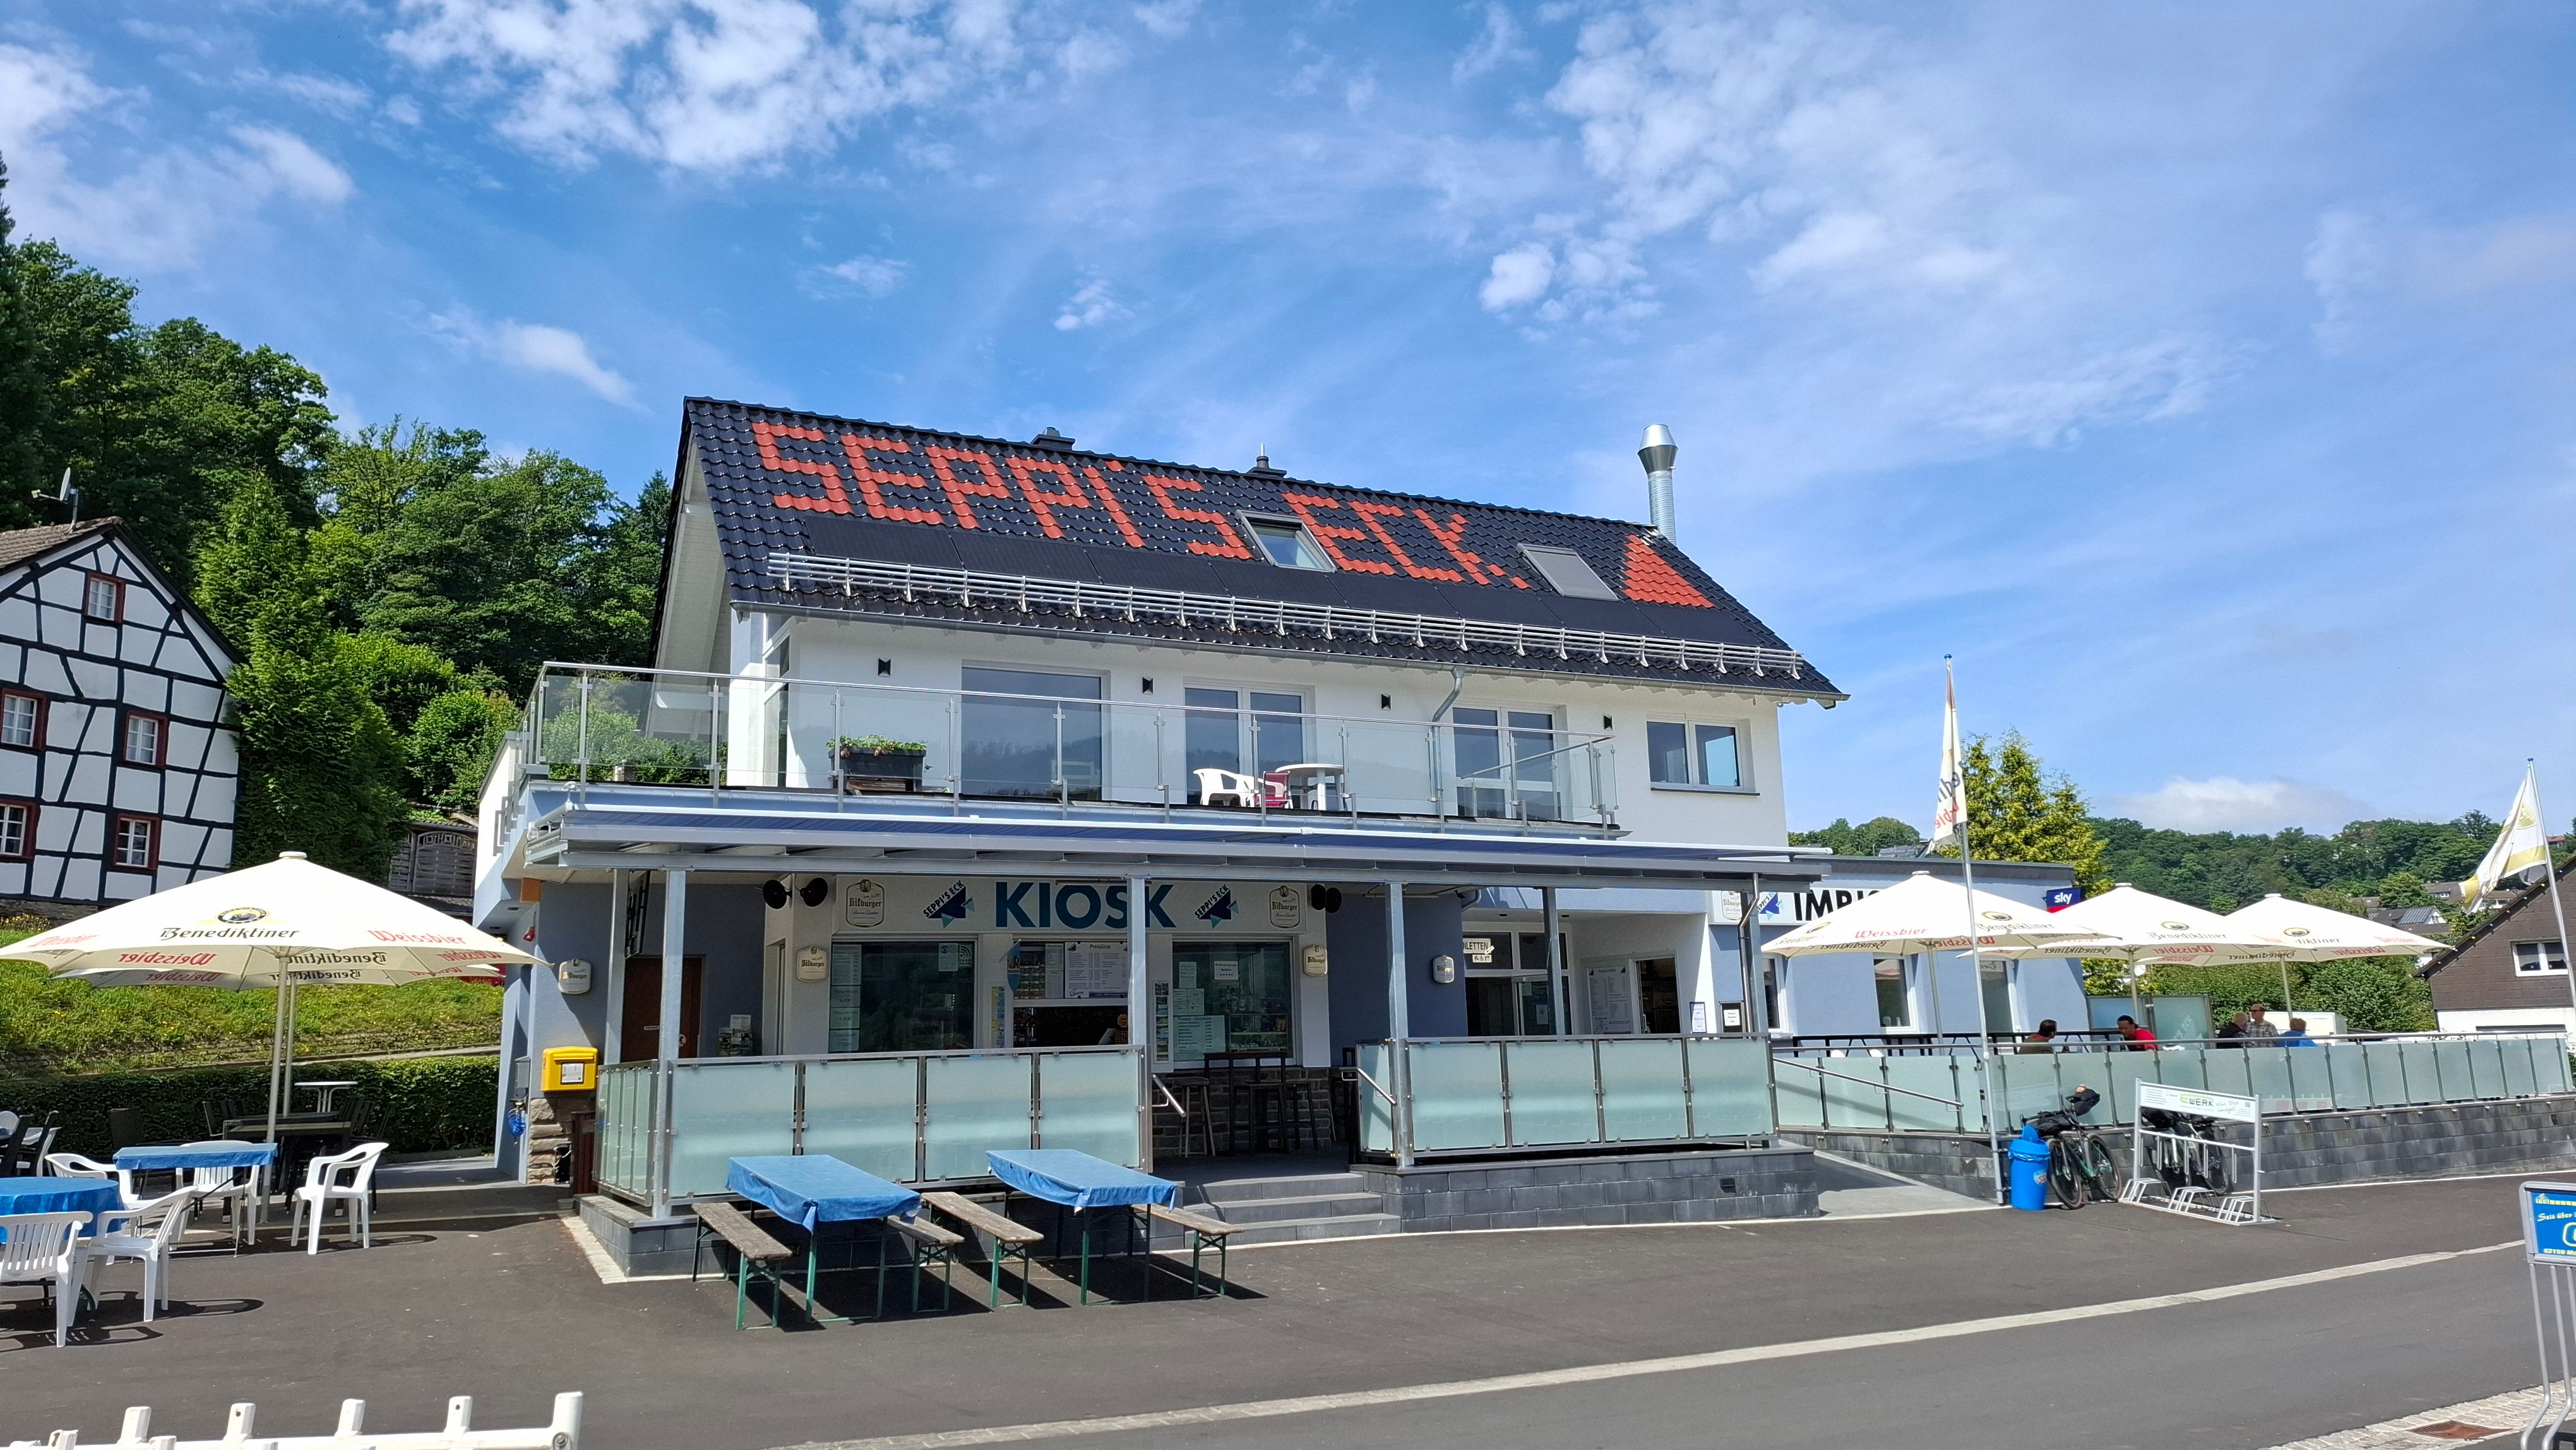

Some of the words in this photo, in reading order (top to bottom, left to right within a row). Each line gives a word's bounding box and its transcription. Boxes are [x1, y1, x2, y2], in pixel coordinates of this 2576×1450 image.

[922, 891, 950, 918] SEPPI'S
[949, 879, 965, 896] ECK
[1194, 894, 1218, 919] SEPPI'S
[1217, 884, 1229, 899] ECK
[2054, 892, 2073, 905] sky
[995, 882, 1178, 930] KIOSK
[160, 927, 300, 941] Benediktiner
[368, 930, 467, 945] Weissbier
[1855, 928, 1928, 938] Weissbier
[1463, 942, 1489, 950] ILETTEN
